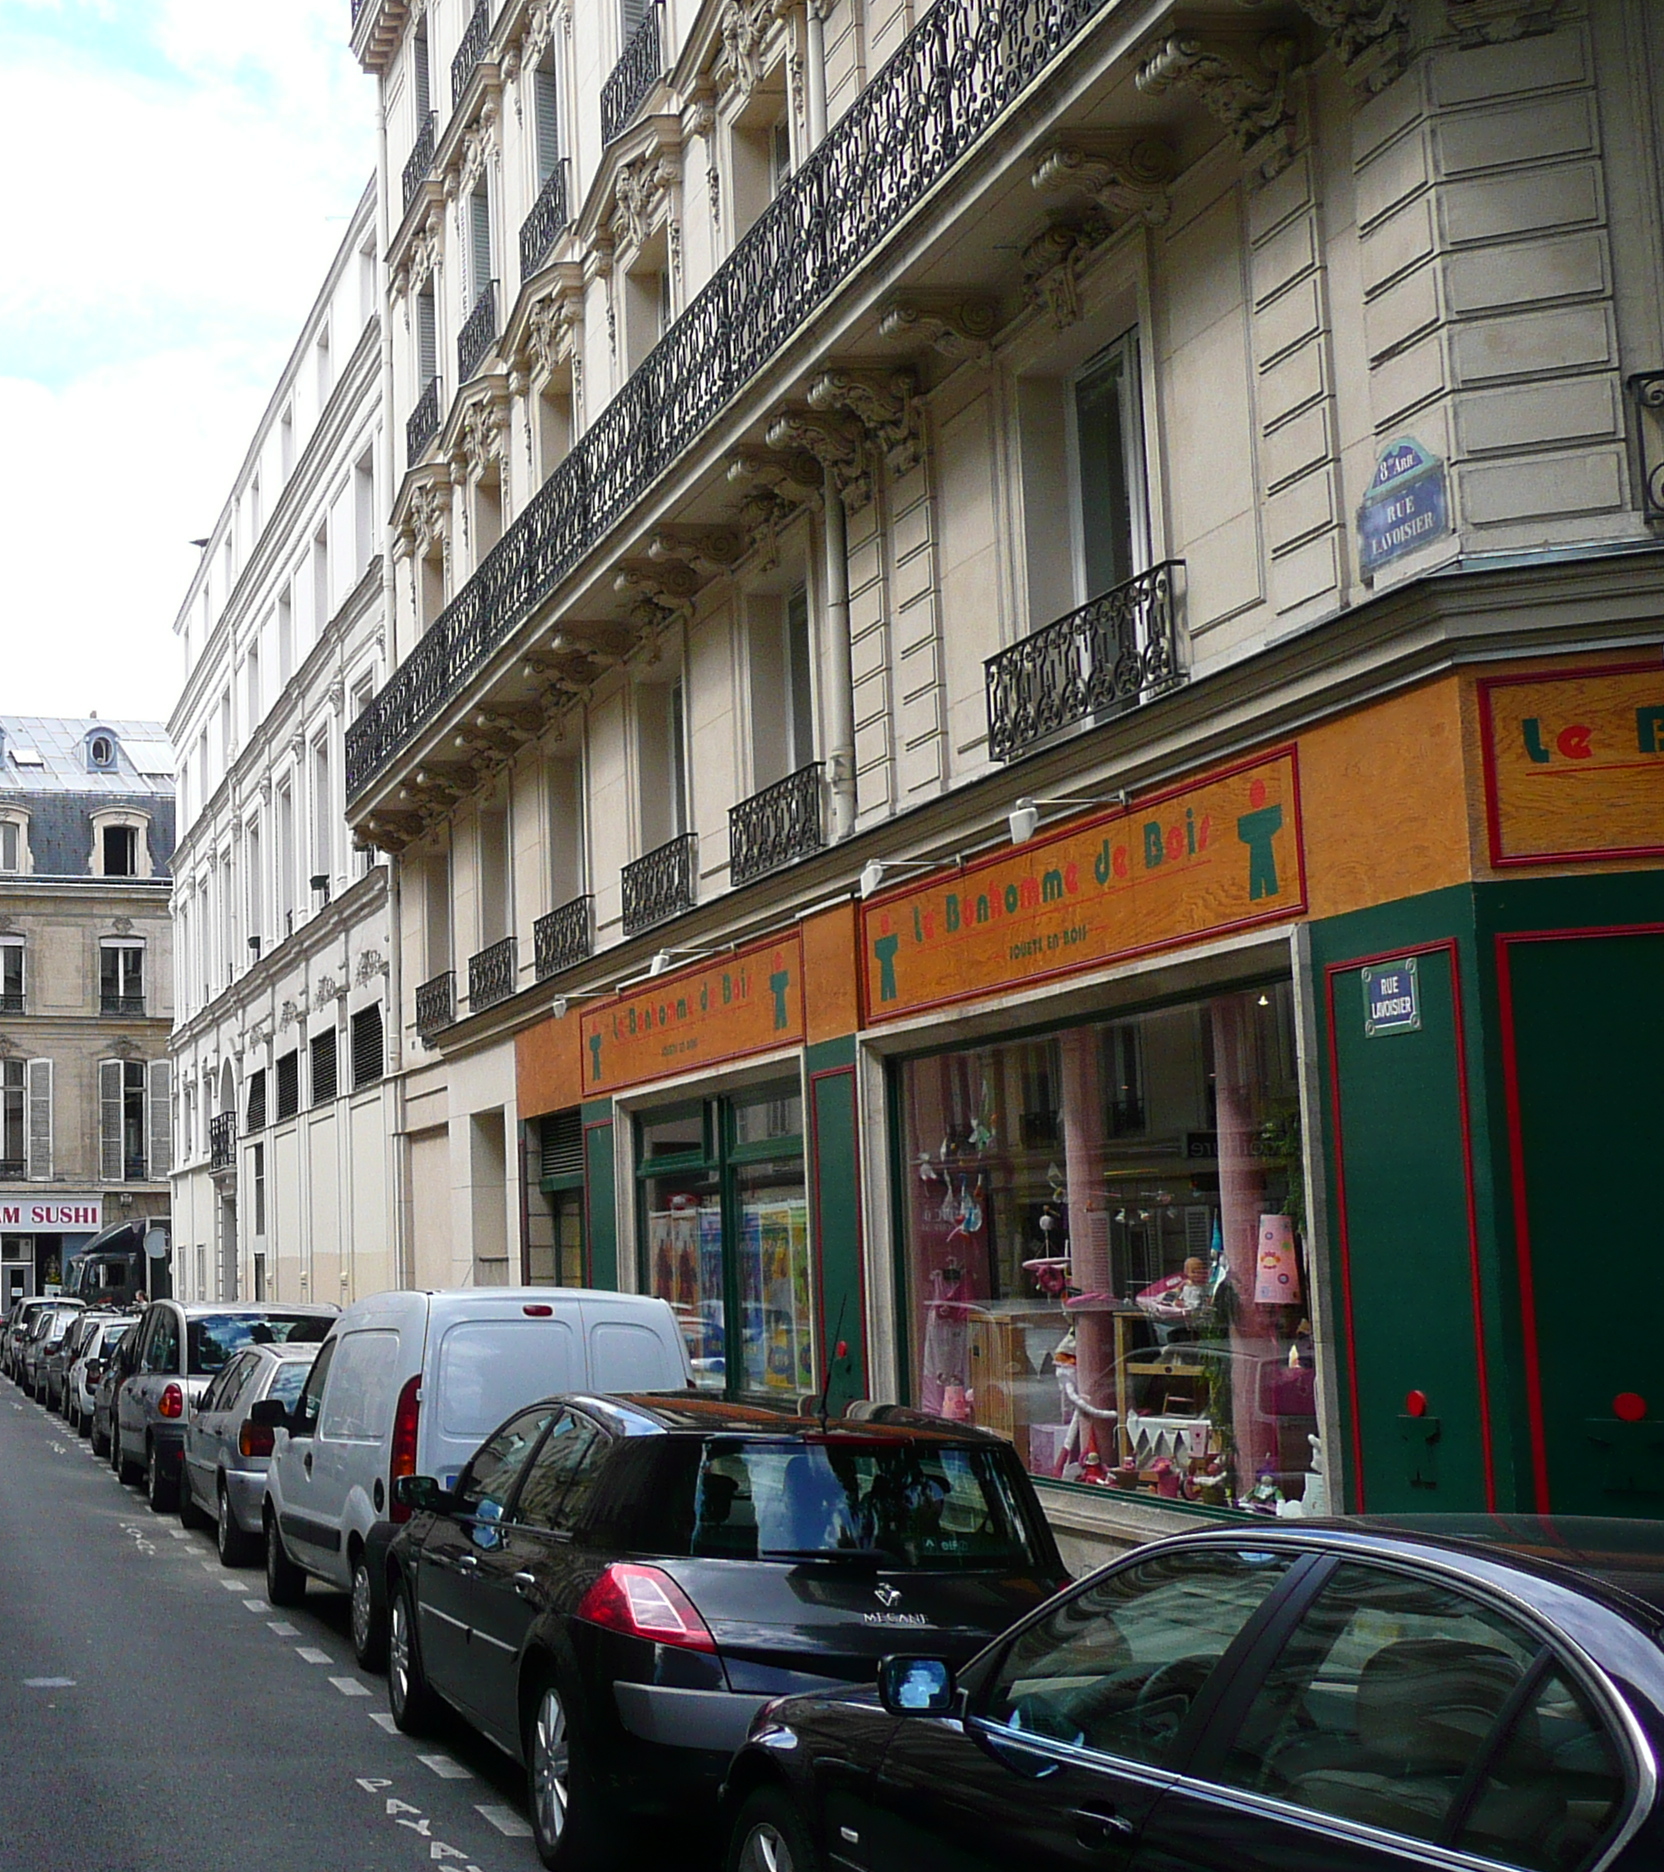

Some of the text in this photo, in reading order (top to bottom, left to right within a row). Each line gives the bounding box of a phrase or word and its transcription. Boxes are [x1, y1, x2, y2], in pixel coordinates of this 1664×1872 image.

[1386, 495, 1415, 523] RUE
[1371, 511, 1434, 555] LAVOISIER
[945, 862, 1079, 934] Bonhomme
[1094, 838, 1128, 886] de
[1142, 806, 1212, 870] Bois
[1380, 975, 1400, 996] RUE
[1371, 995, 1412, 1019] LAVOISIER
[31, 1206, 98, 1224] SUSHI
